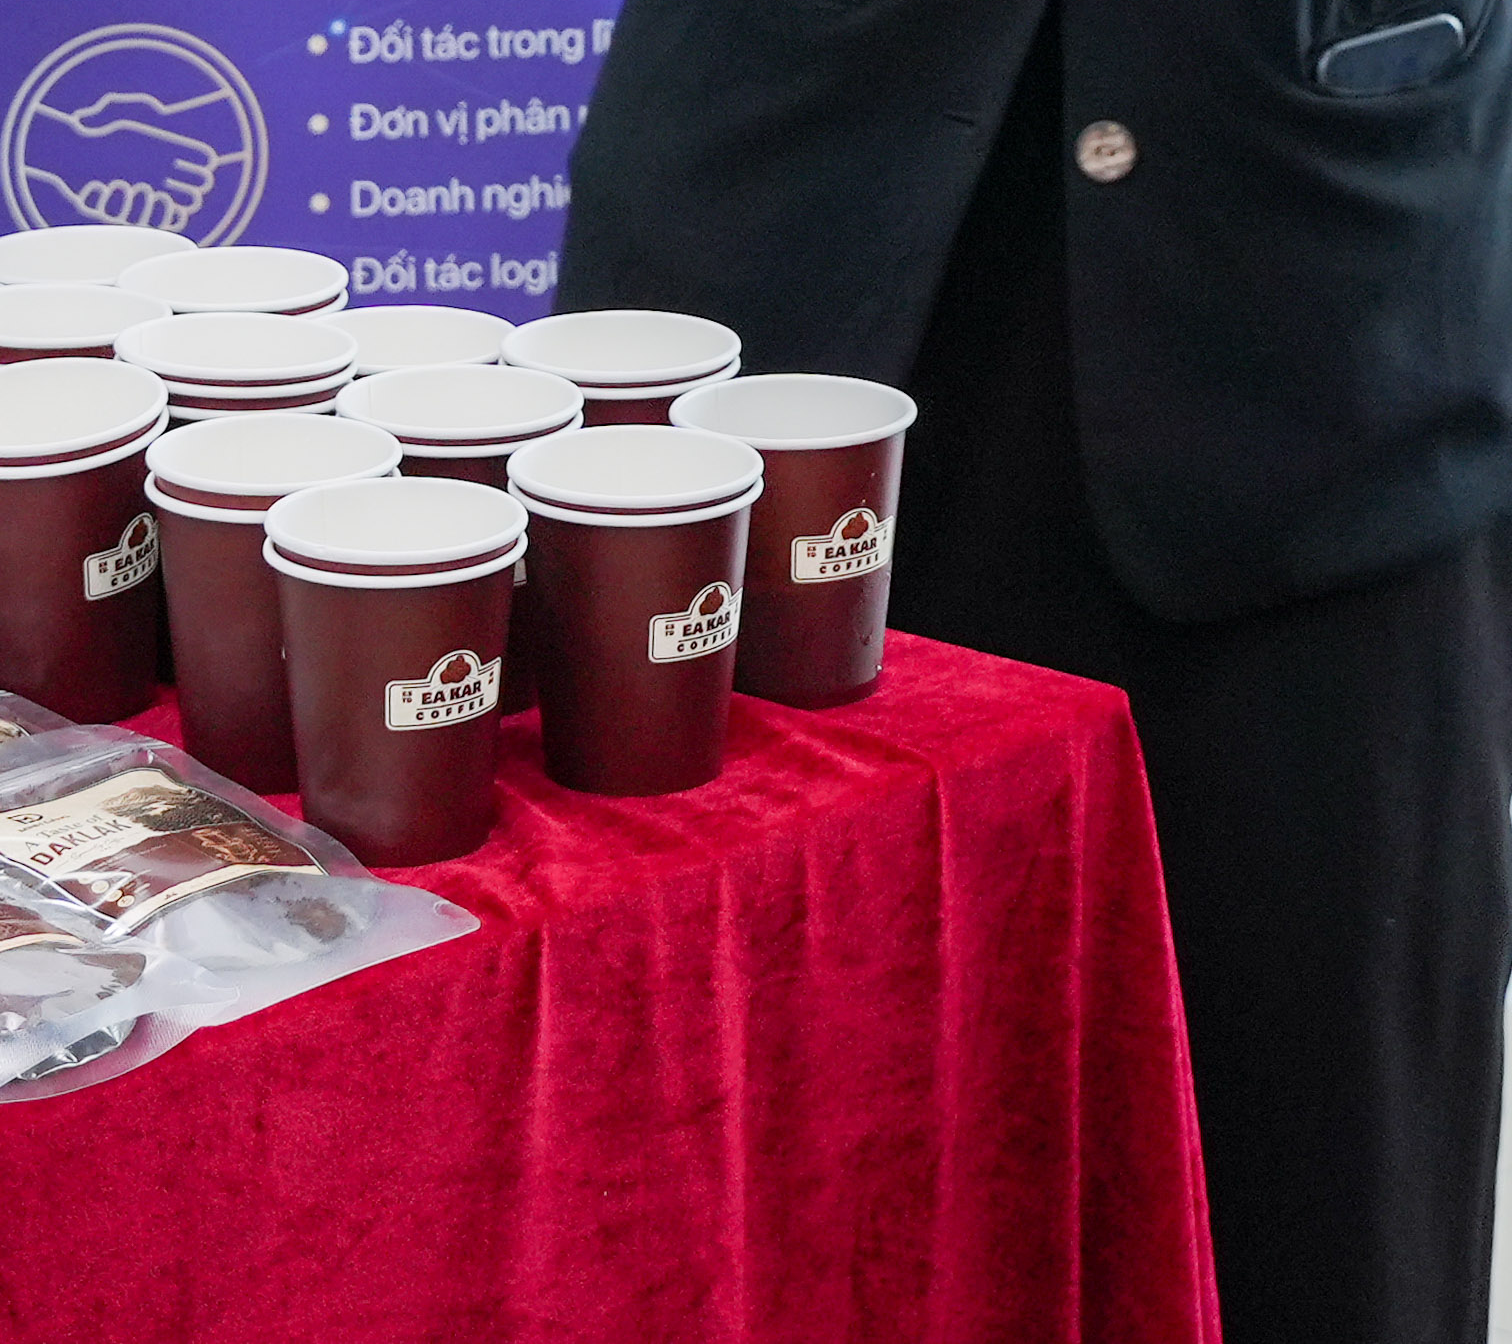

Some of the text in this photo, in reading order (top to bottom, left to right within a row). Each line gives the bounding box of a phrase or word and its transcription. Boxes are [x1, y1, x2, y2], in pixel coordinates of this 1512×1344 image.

[420, 23, 481, 62] tác
[487, 25, 586, 65] trong
[349, 103, 430, 141] Đơn
[437, 99, 468, 146] vị
[475, 96, 571, 144] phân
[350, 174, 571, 221] Doanh nghi
[352, 248, 558, 296] Đối tác logi
[825, 546, 846, 559] EA
[849, 537, 877, 555] KAR
[115, 553, 134, 571] EA
[819, 552, 879, 574] COFFEE
[682, 624, 704, 637] EA
[421, 680, 482, 705] EA KAR
[416, 697, 484, 721] COFFEE
[29, 819, 132, 866] DAKLAK
